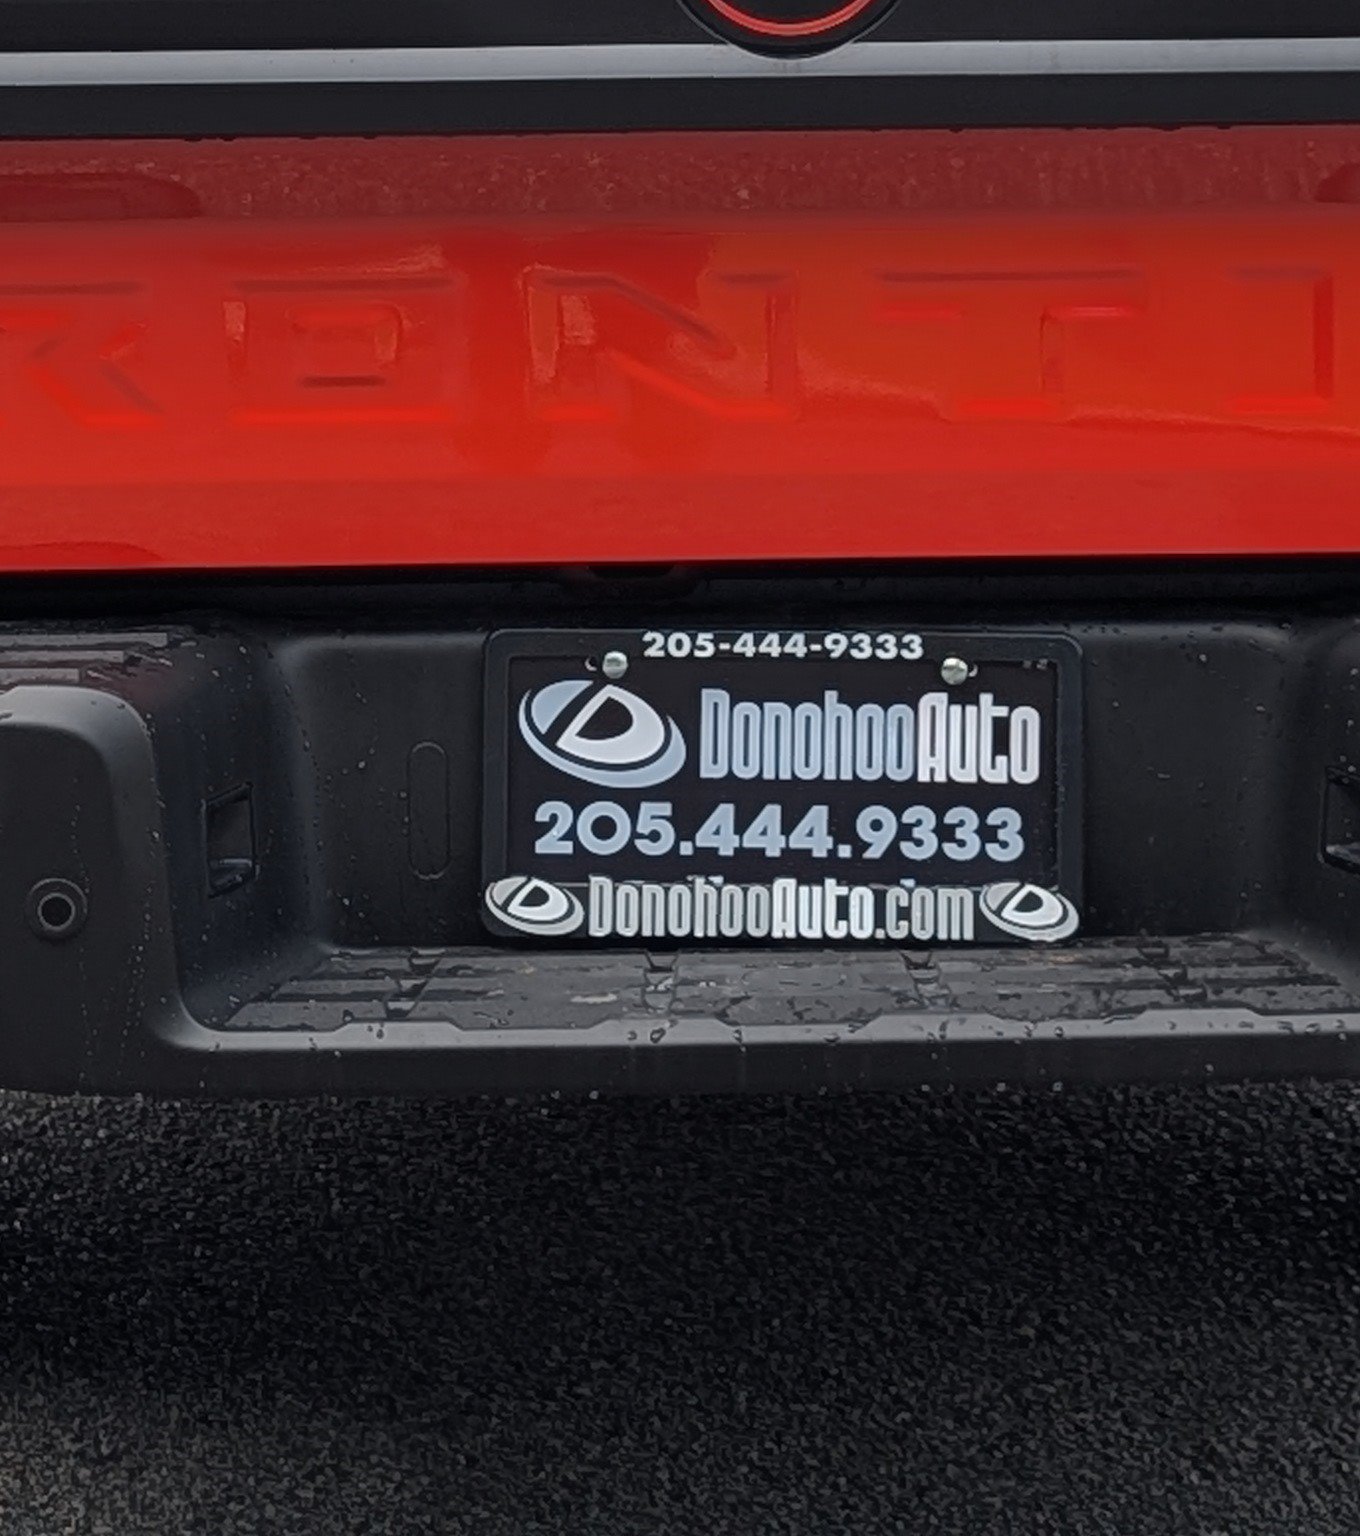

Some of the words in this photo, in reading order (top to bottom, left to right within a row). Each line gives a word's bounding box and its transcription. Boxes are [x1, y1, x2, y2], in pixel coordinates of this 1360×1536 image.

[642, 632, 924, 659] 205-444-9333
[700, 688, 1041, 784] DonohooAuto
[534, 801, 1026, 861] 205.444.9333
[588, 875, 975, 941] DonohooAuto.com
